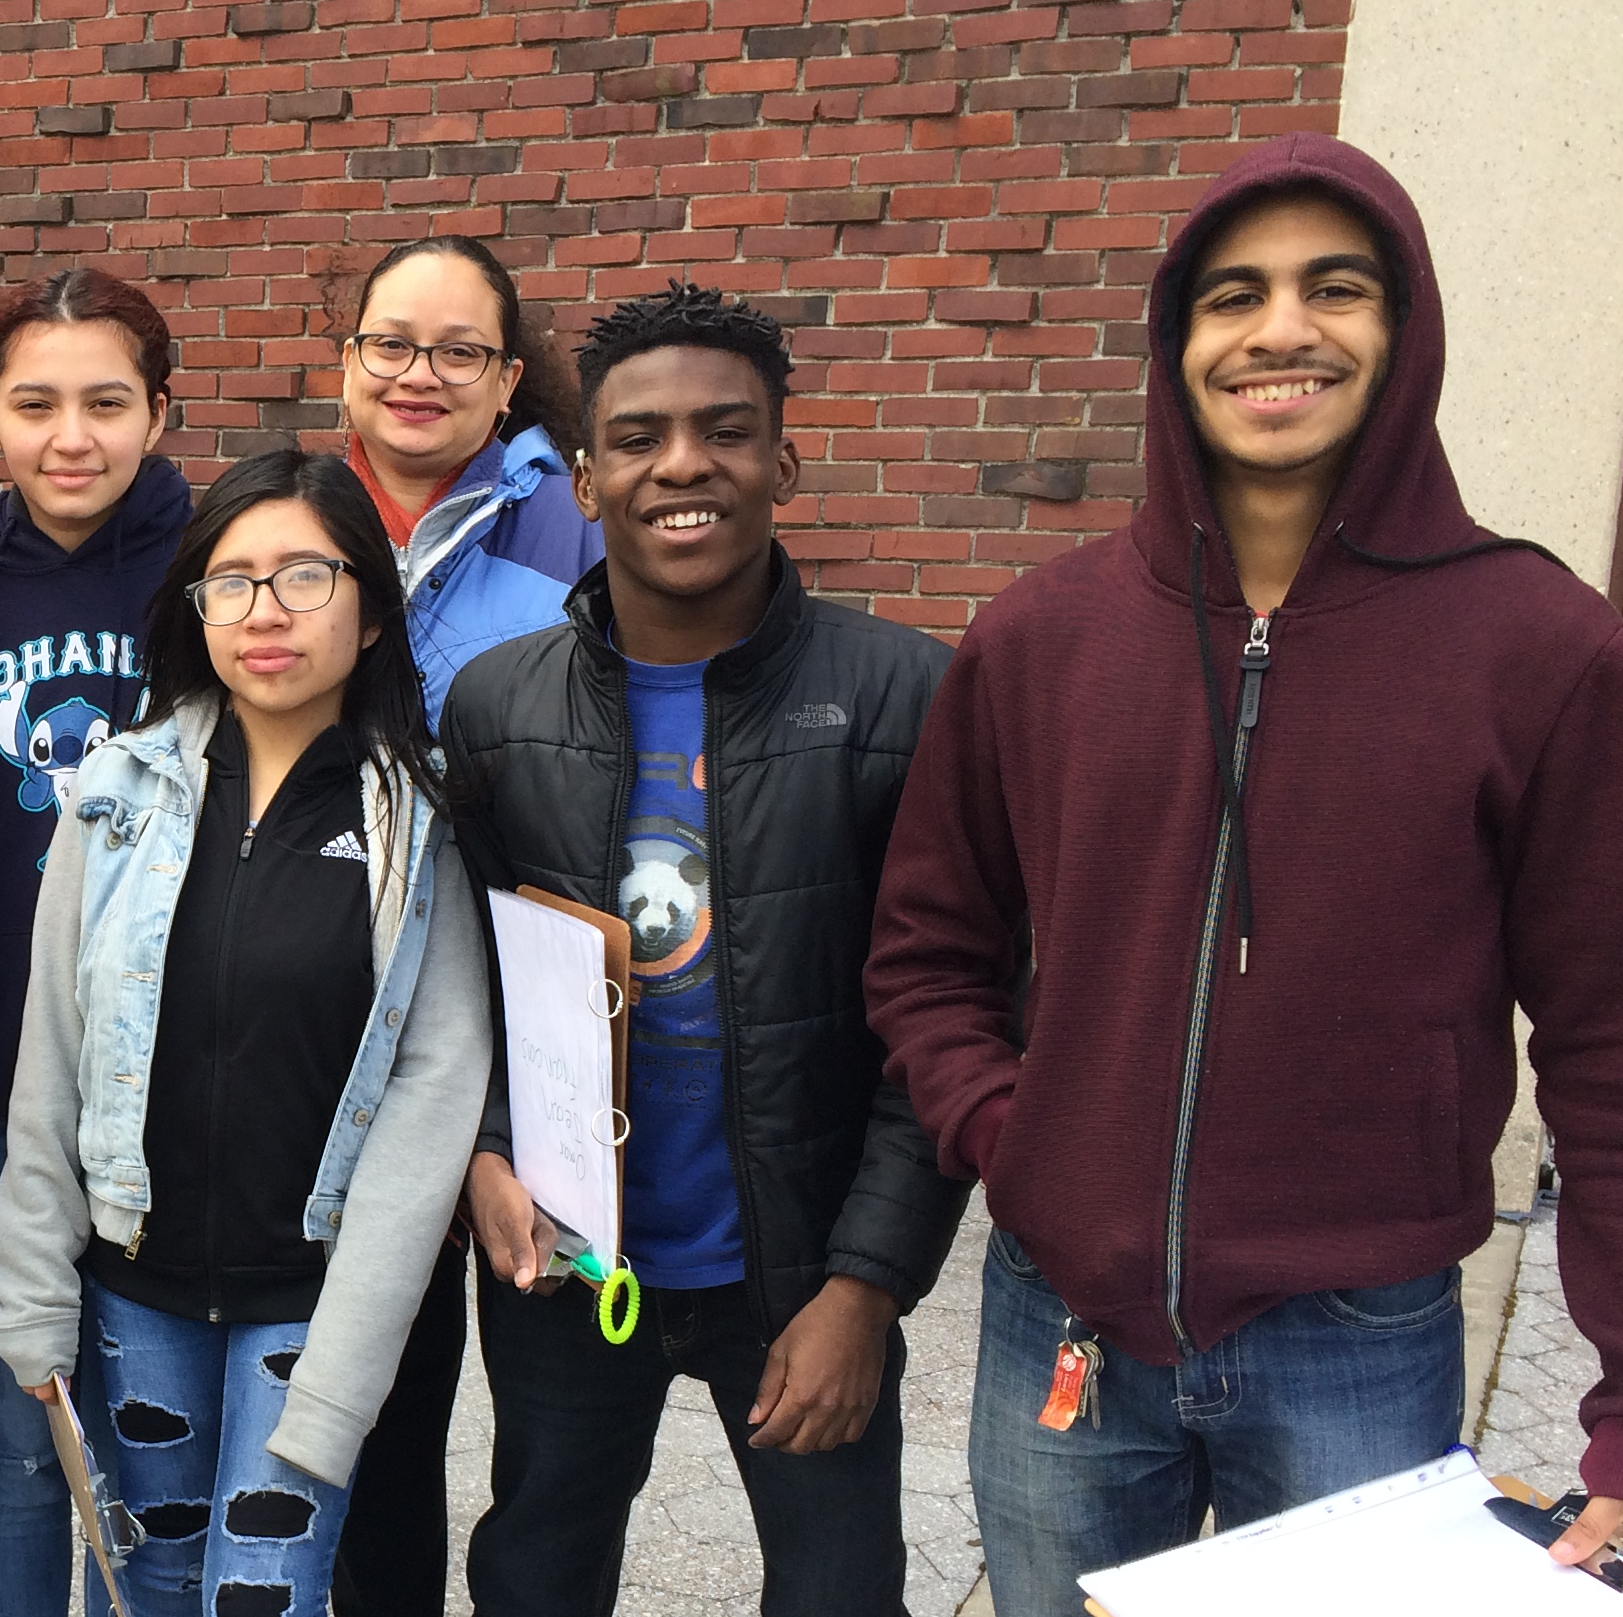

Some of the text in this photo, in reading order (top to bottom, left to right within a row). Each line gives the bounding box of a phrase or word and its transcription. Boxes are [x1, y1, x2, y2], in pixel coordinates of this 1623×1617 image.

[803, 703, 826, 713] THE
[784, 711, 827, 722] NORTH
[796, 719, 827, 729] FACE
[319, 846, 368, 863] adidas
